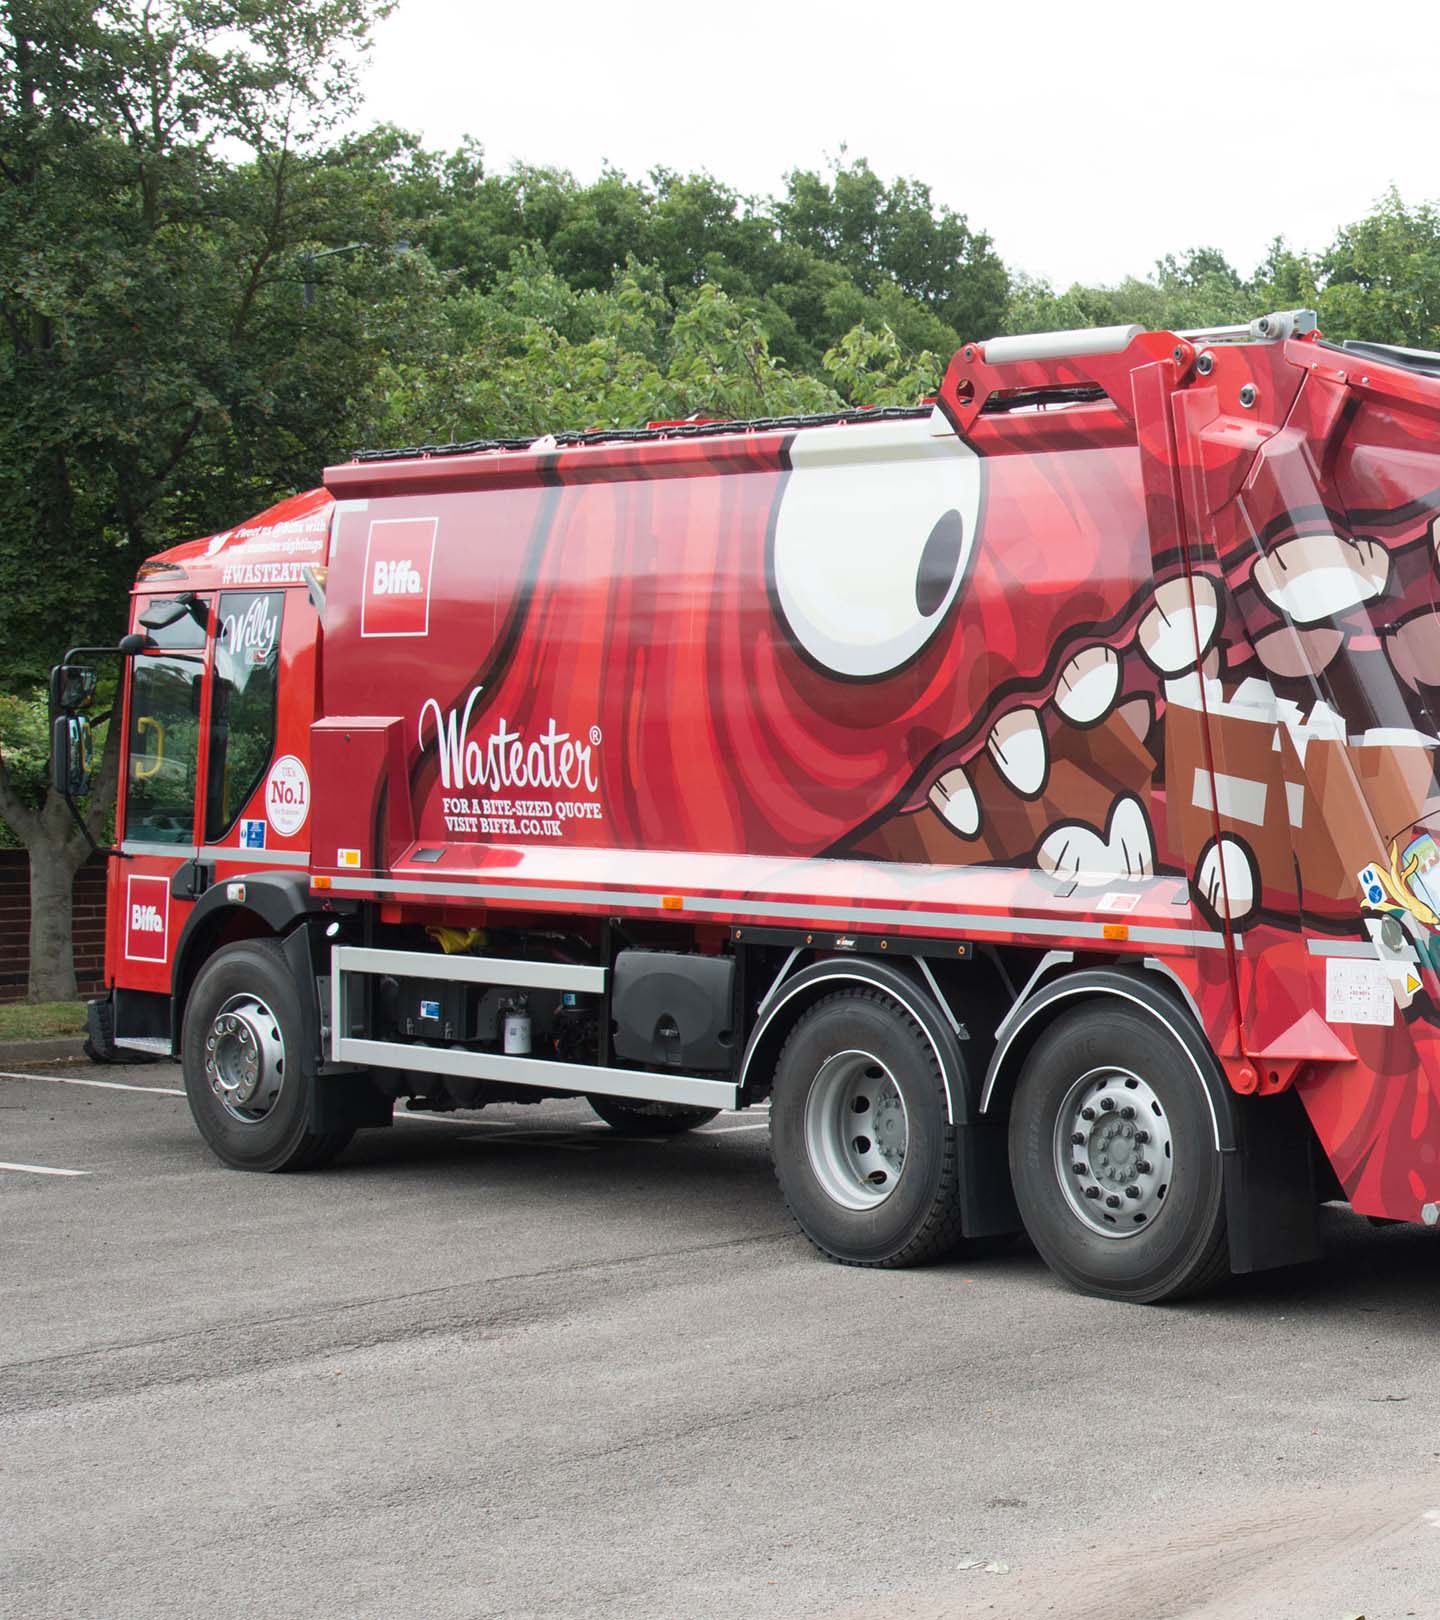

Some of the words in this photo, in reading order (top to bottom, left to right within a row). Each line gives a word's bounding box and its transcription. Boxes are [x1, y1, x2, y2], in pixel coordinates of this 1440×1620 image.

[373, 560, 421, 594] Biffa
[221, 596, 278, 658] Willy
[271, 780, 305, 804] No.1
[442, 798, 470, 814] FOR
[472, 799, 481, 814] A
[483, 800, 552, 817] BITE-SIZED
[555, 802, 602, 820] QUOTE
[444, 816, 478, 832] VISIT
[480, 817, 562, 836] BIFFA.CO.UK
[132, 904, 163, 932] Biffa
